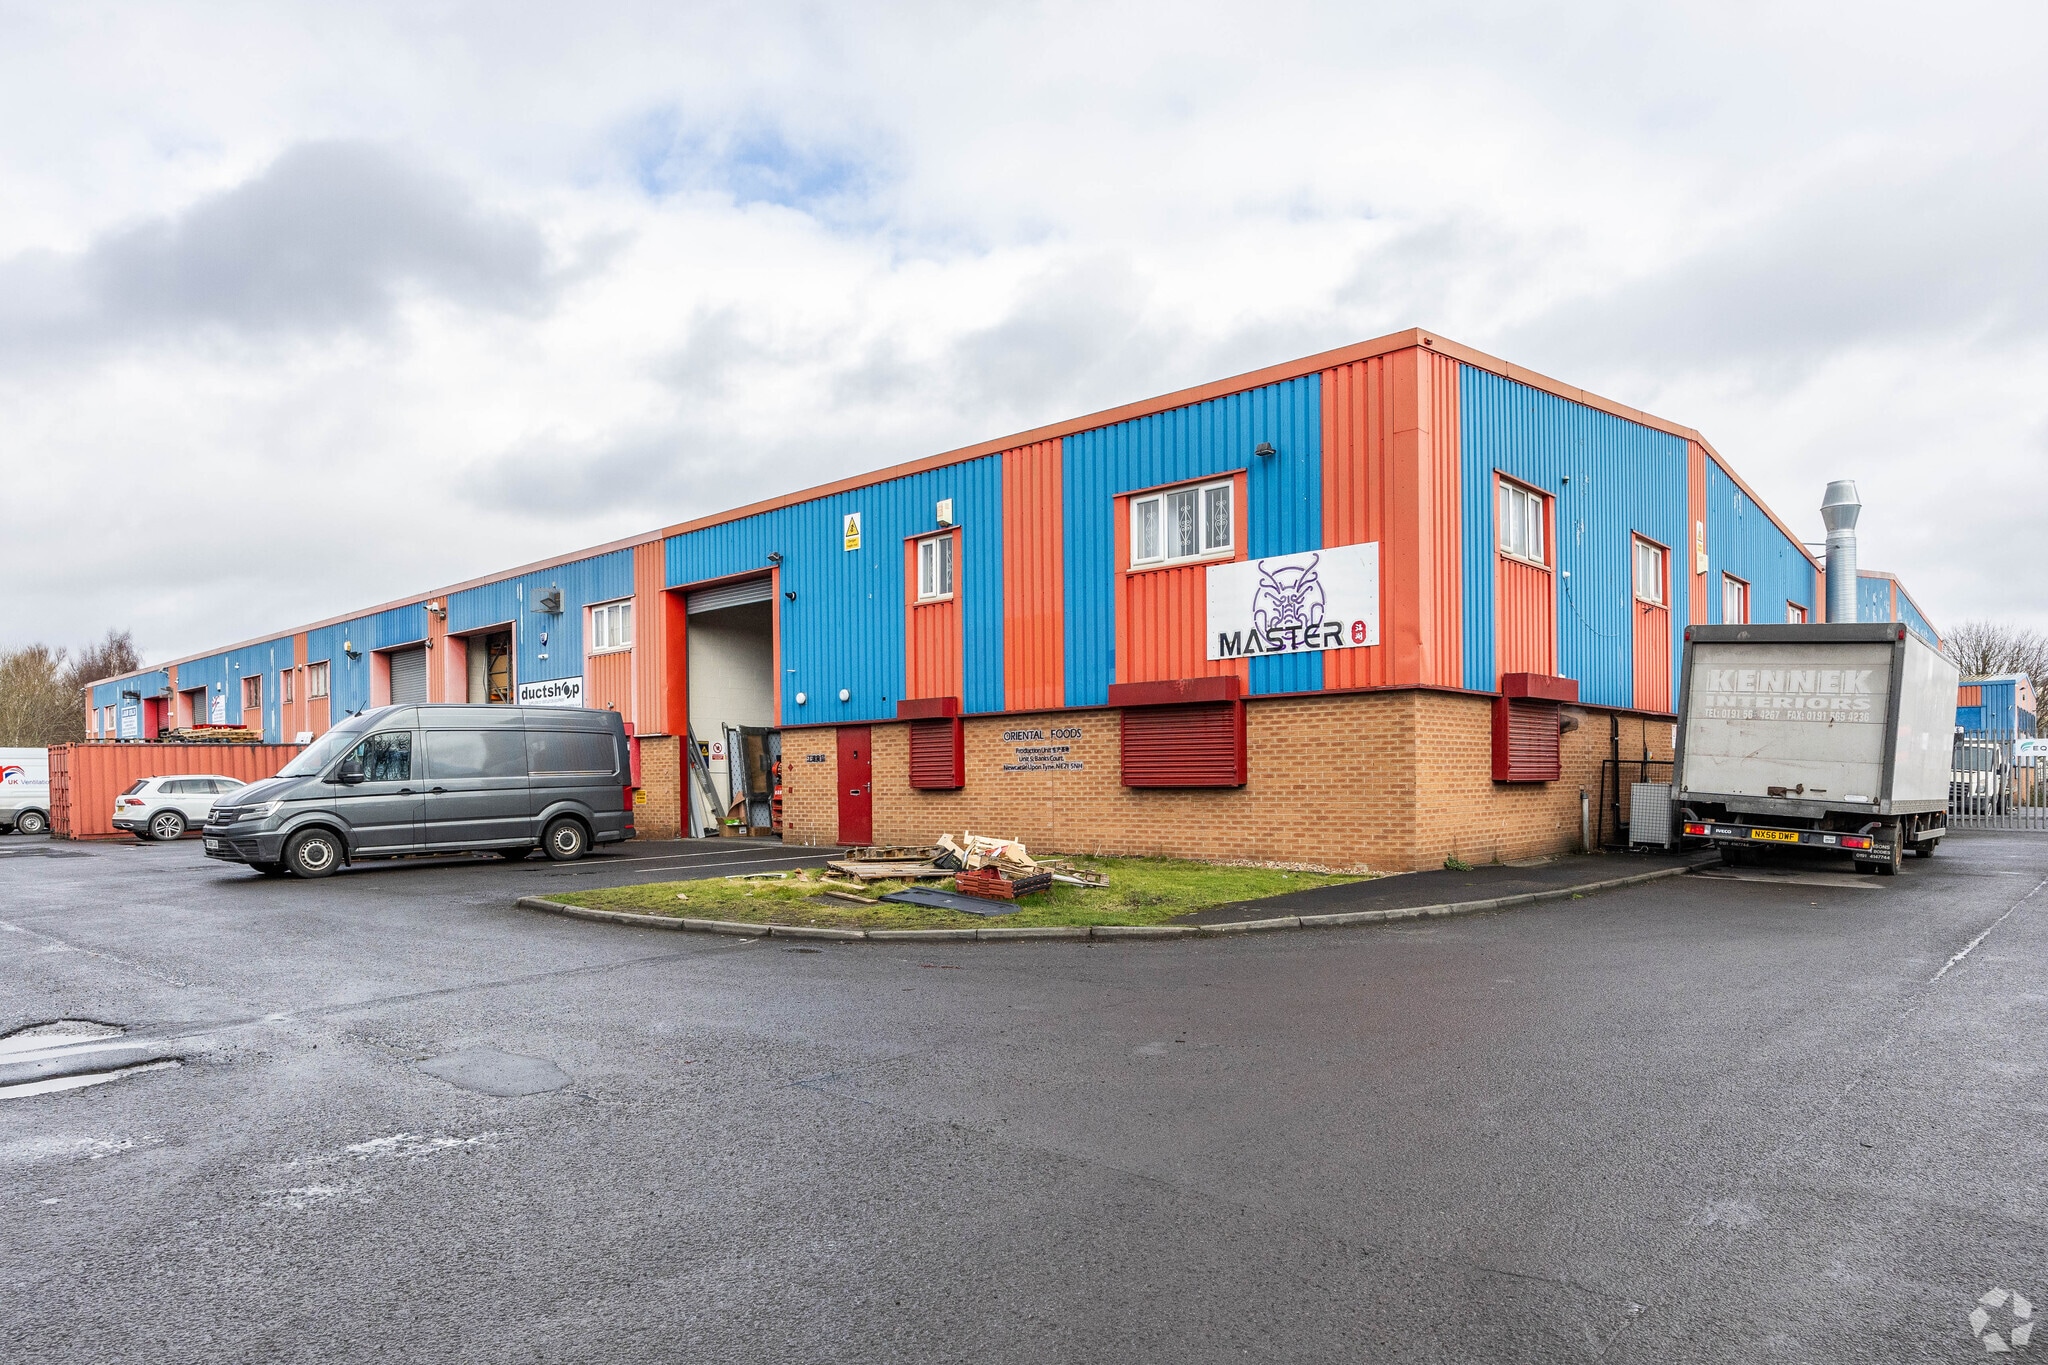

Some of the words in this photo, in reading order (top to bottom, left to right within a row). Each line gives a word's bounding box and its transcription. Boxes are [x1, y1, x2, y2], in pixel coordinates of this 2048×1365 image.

[1219, 621, 1344, 657] MASTER
[1706, 669, 1873, 696] KENNEK
[521, 682, 580, 700] ductshop
[1706, 696, 1872, 710] INTERIORS
[1705, 709, 1720, 719] TEL:
[1721, 709, 1740, 719] 0191
[1760, 710, 1780, 720] 4267
[1787, 710, 1805, 720] FAX:
[1806, 711, 1827, 721] 0191
[1830, 712, 1846, 722] 565
[1848, 712, 1870, 722] 4236
[1003, 730, 1044, 741] ORIENTAL
[1050, 728, 1082, 739] FOODS
[1754, 830, 1777, 839] NX56
[1778, 832, 1795, 841] DWF
